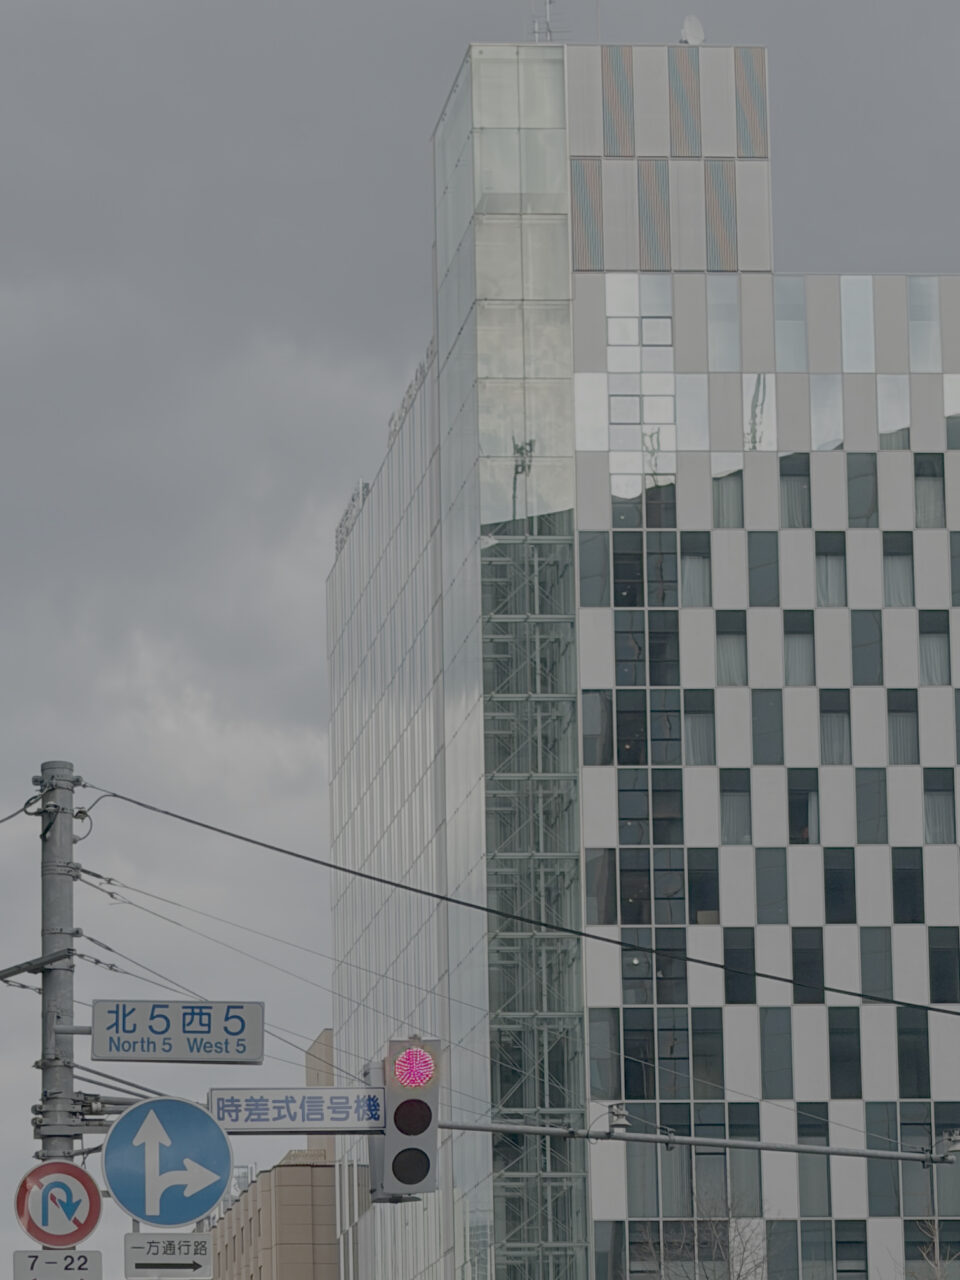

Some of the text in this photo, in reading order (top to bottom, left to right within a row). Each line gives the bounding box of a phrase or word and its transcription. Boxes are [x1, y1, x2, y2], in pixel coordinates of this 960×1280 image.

[108, 1036, 247, 1054] North 5 West 5
[216, 1095, 381, 1123] 時差式信号機
[131, 1240, 208, 1256] 一方通行路
